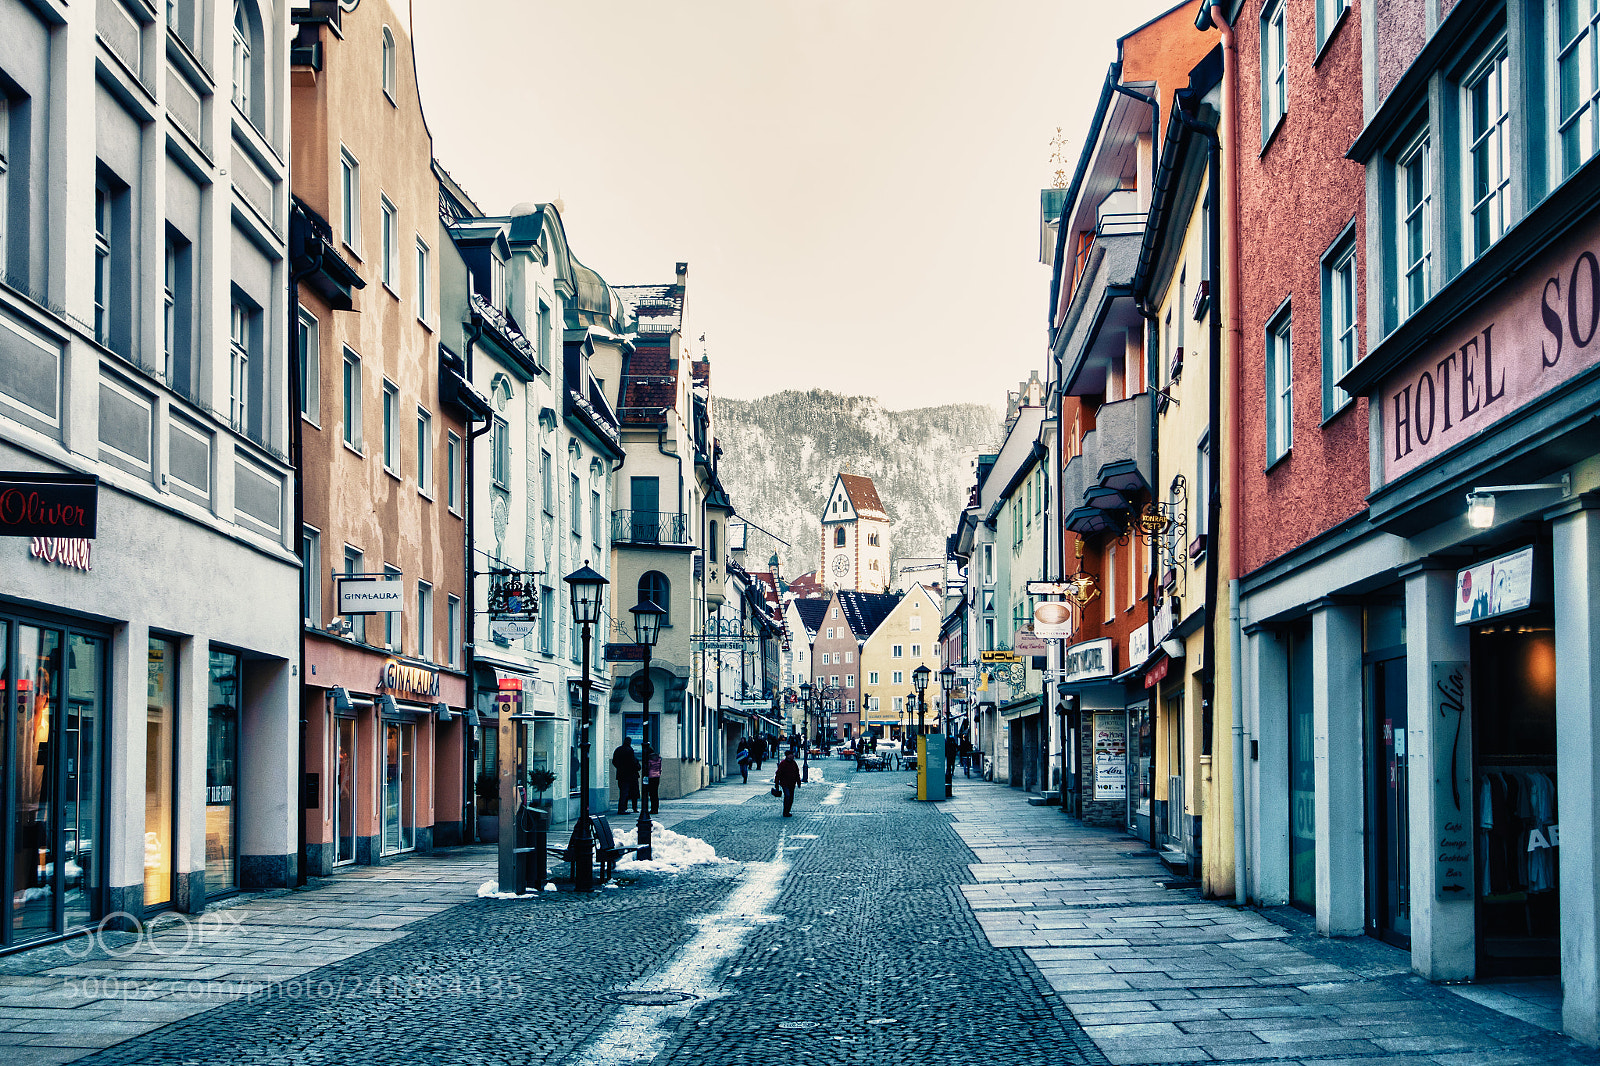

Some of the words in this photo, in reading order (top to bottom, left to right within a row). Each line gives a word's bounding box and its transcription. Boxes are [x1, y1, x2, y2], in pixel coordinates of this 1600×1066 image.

[1393, 323, 1505, 462] HOTEL
[0, 488, 87, 526] Oliver
[344, 592, 399, 600] GINALAURA
[384, 663, 440, 697] GINALAURA
[1438, 853, 1470, 862] Cocktail
[1445, 869, 1463, 878] Bar
